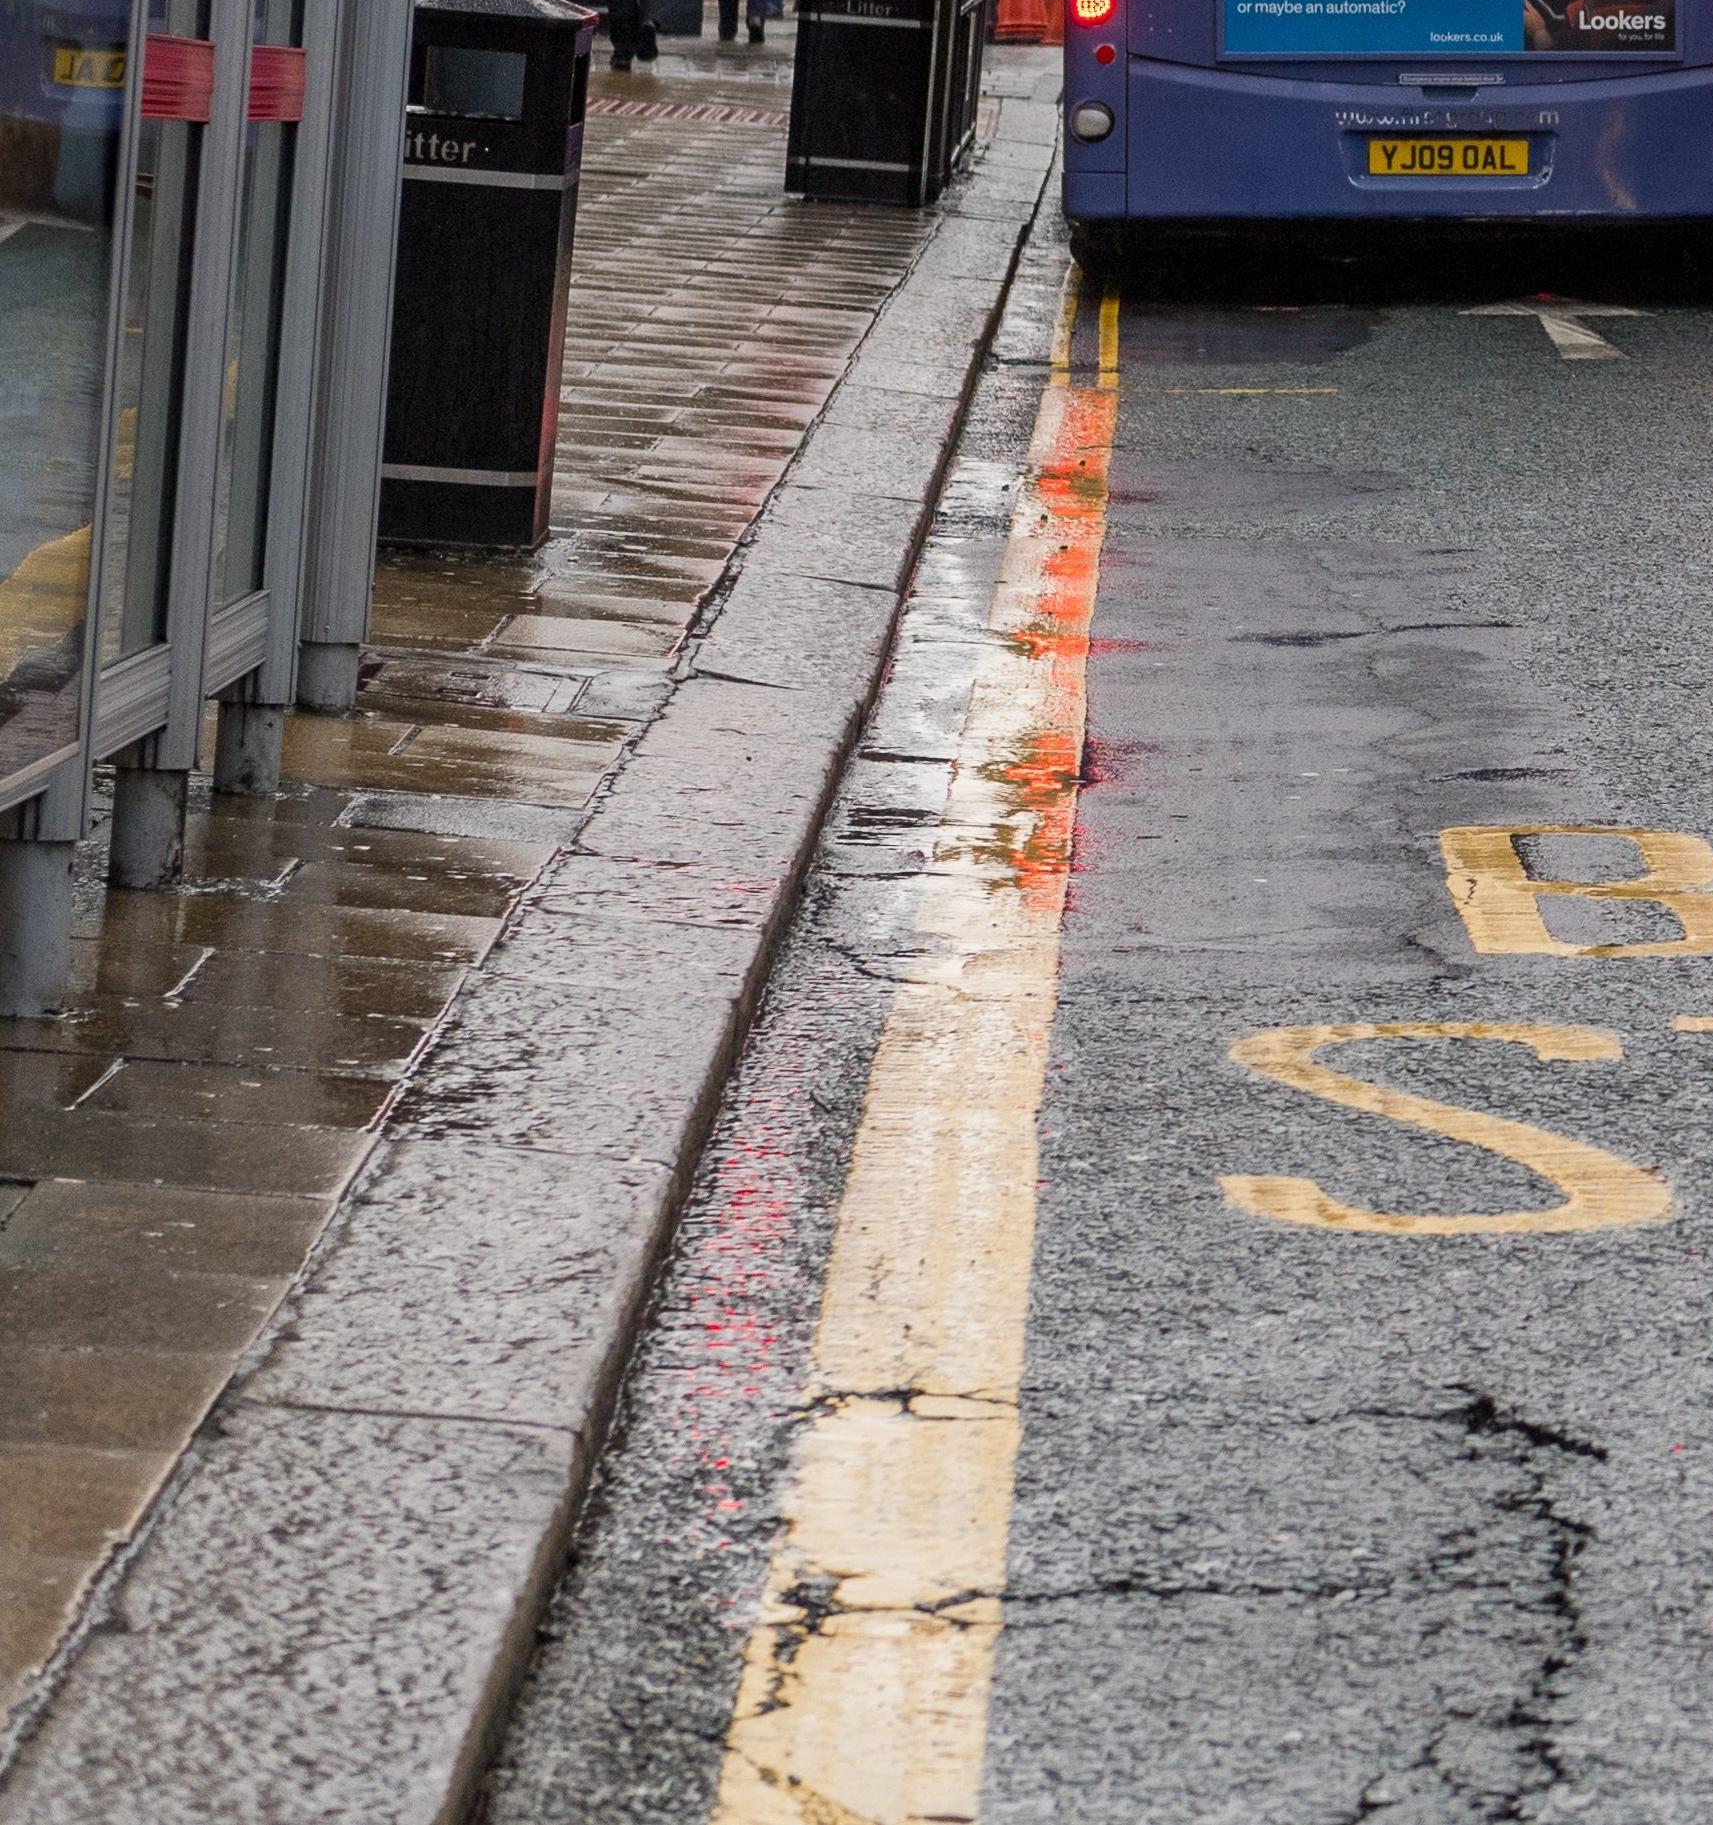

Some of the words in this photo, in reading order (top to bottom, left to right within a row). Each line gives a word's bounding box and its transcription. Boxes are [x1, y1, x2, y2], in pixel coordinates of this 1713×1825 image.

[1237, 2, 1252, 14] or
[1254, 0, 1303, 16] maybe
[1305, 2, 1323, 14] an
[1326, 0, 1406, 14] automatic?
[1579, 10, 1666, 31] Lookers
[1430, 32, 1503, 42] lookers.co.uk
[1381, 145, 1453, 170] YJ09
[1462, 145, 1516, 170] OAL
